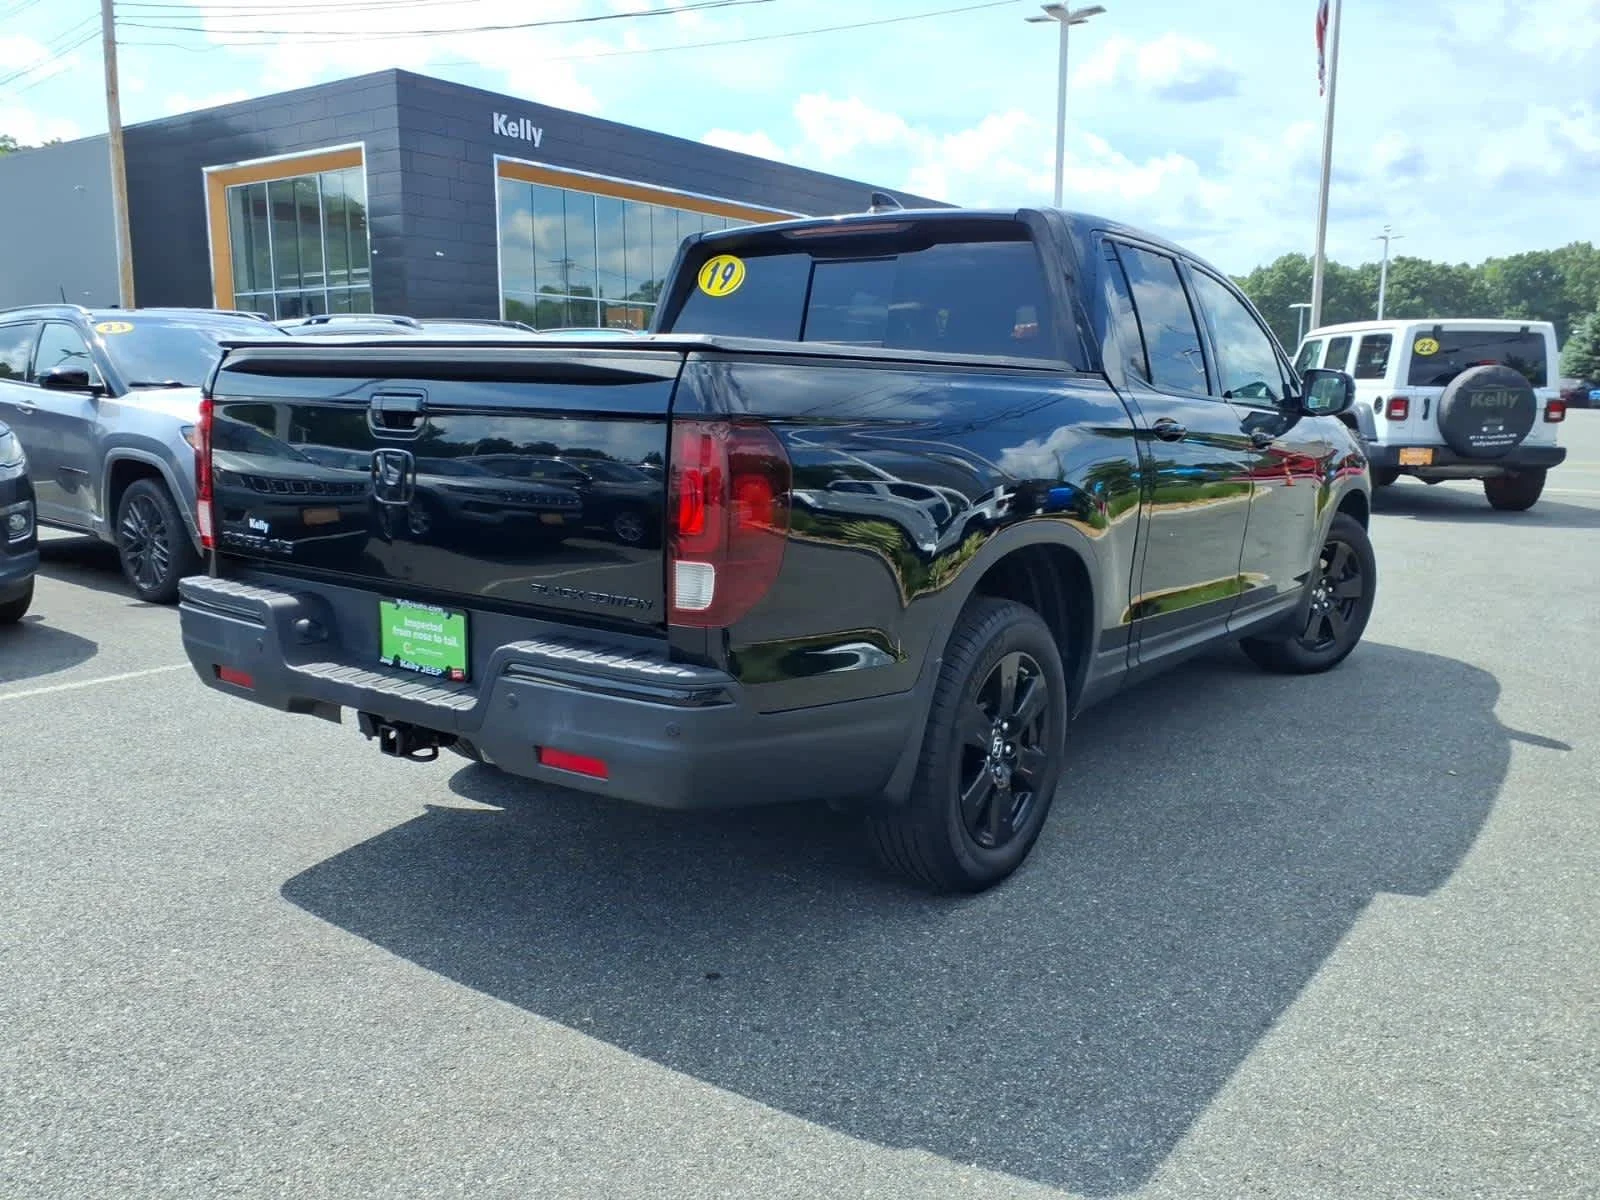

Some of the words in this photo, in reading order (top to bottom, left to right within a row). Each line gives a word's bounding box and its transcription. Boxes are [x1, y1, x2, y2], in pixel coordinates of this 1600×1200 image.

[493, 112, 543, 148] Kelly
[707, 261, 736, 290] 19
[1419, 341, 1434, 352] 22
[1470, 391, 1520, 409] Kelly
[248, 517, 270, 534] Kelly
[587, 590, 654, 610] EDITION
[403, 616, 443, 633] Inspected
[392, 625, 412, 639] from
[413, 631, 433, 642] nose
[433, 633, 442, 643] to
[399, 659, 420, 672] Kelly
[420, 664, 443, 677] JEEP
